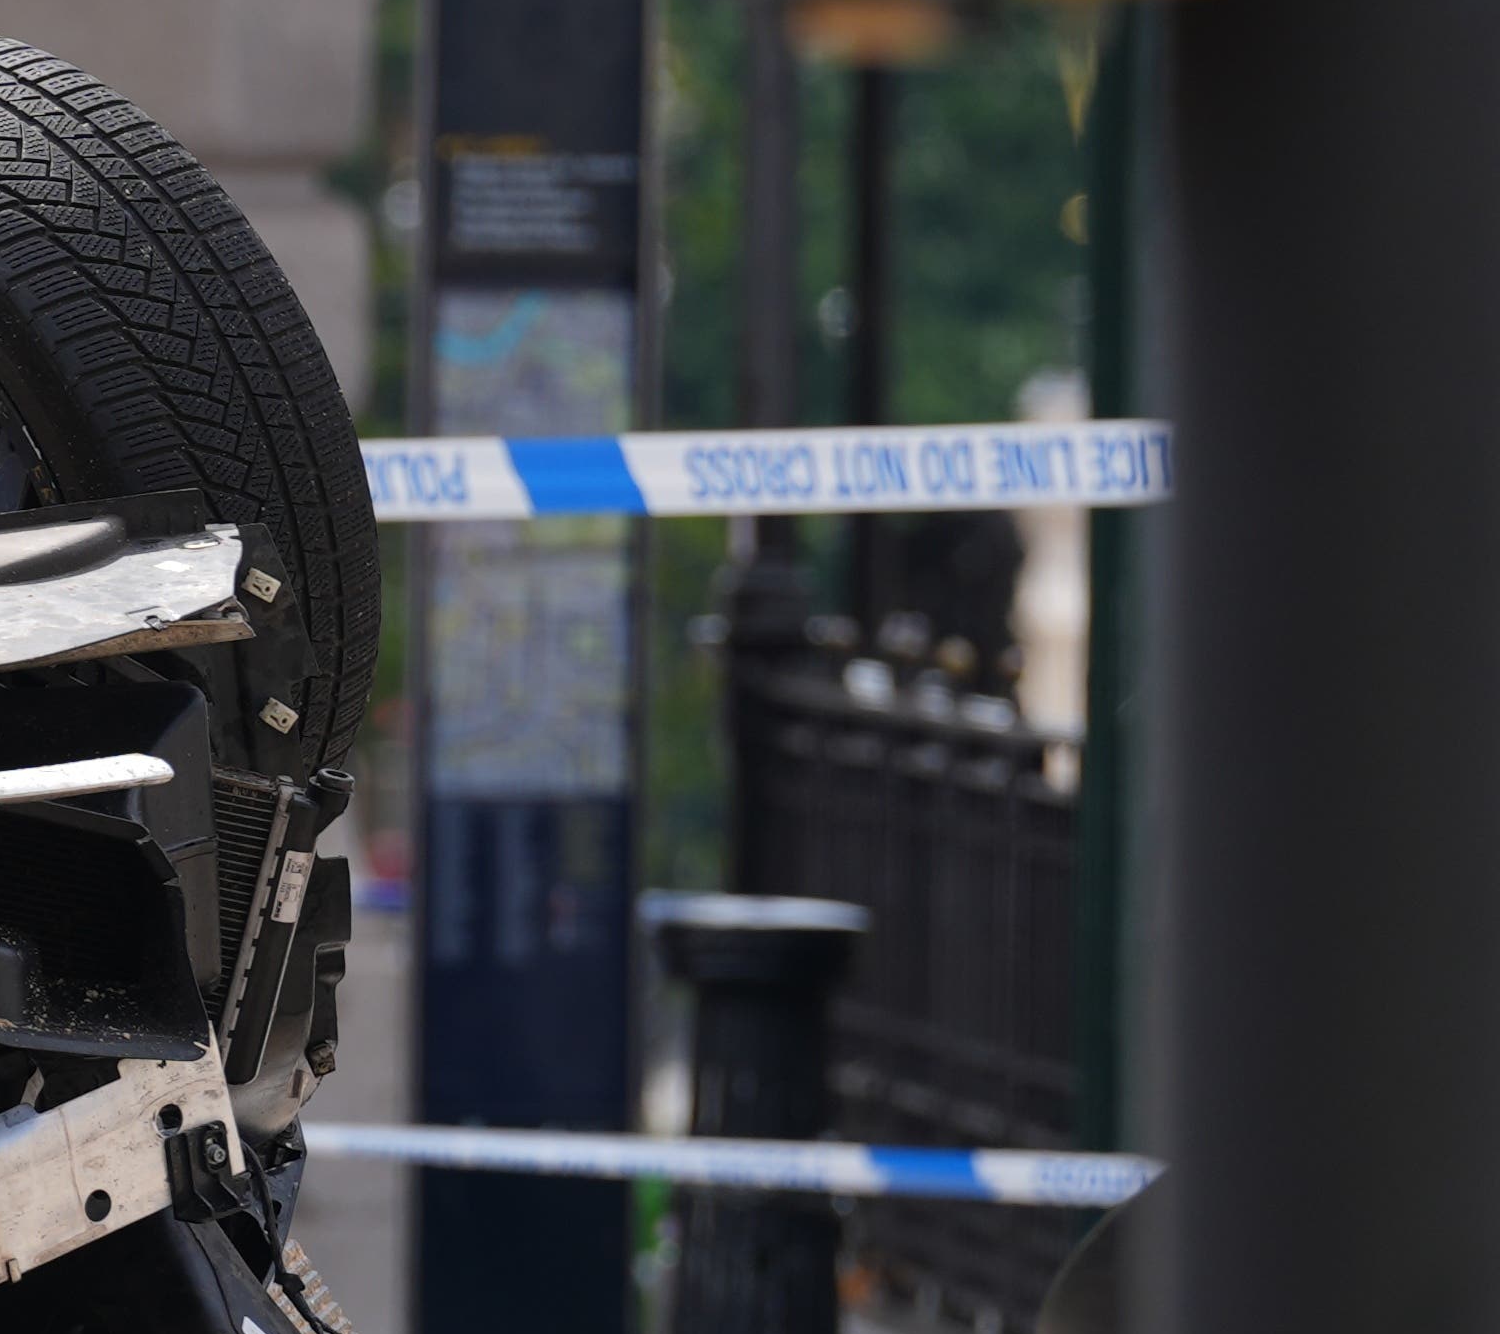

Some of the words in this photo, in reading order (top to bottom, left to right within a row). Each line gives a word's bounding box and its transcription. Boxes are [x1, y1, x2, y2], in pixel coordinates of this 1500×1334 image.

[684, 445, 816, 500] CROSS
[833, 442, 910, 496] NOT
[918, 438, 976, 494] DO
[992, 435, 1077, 491] LINE
